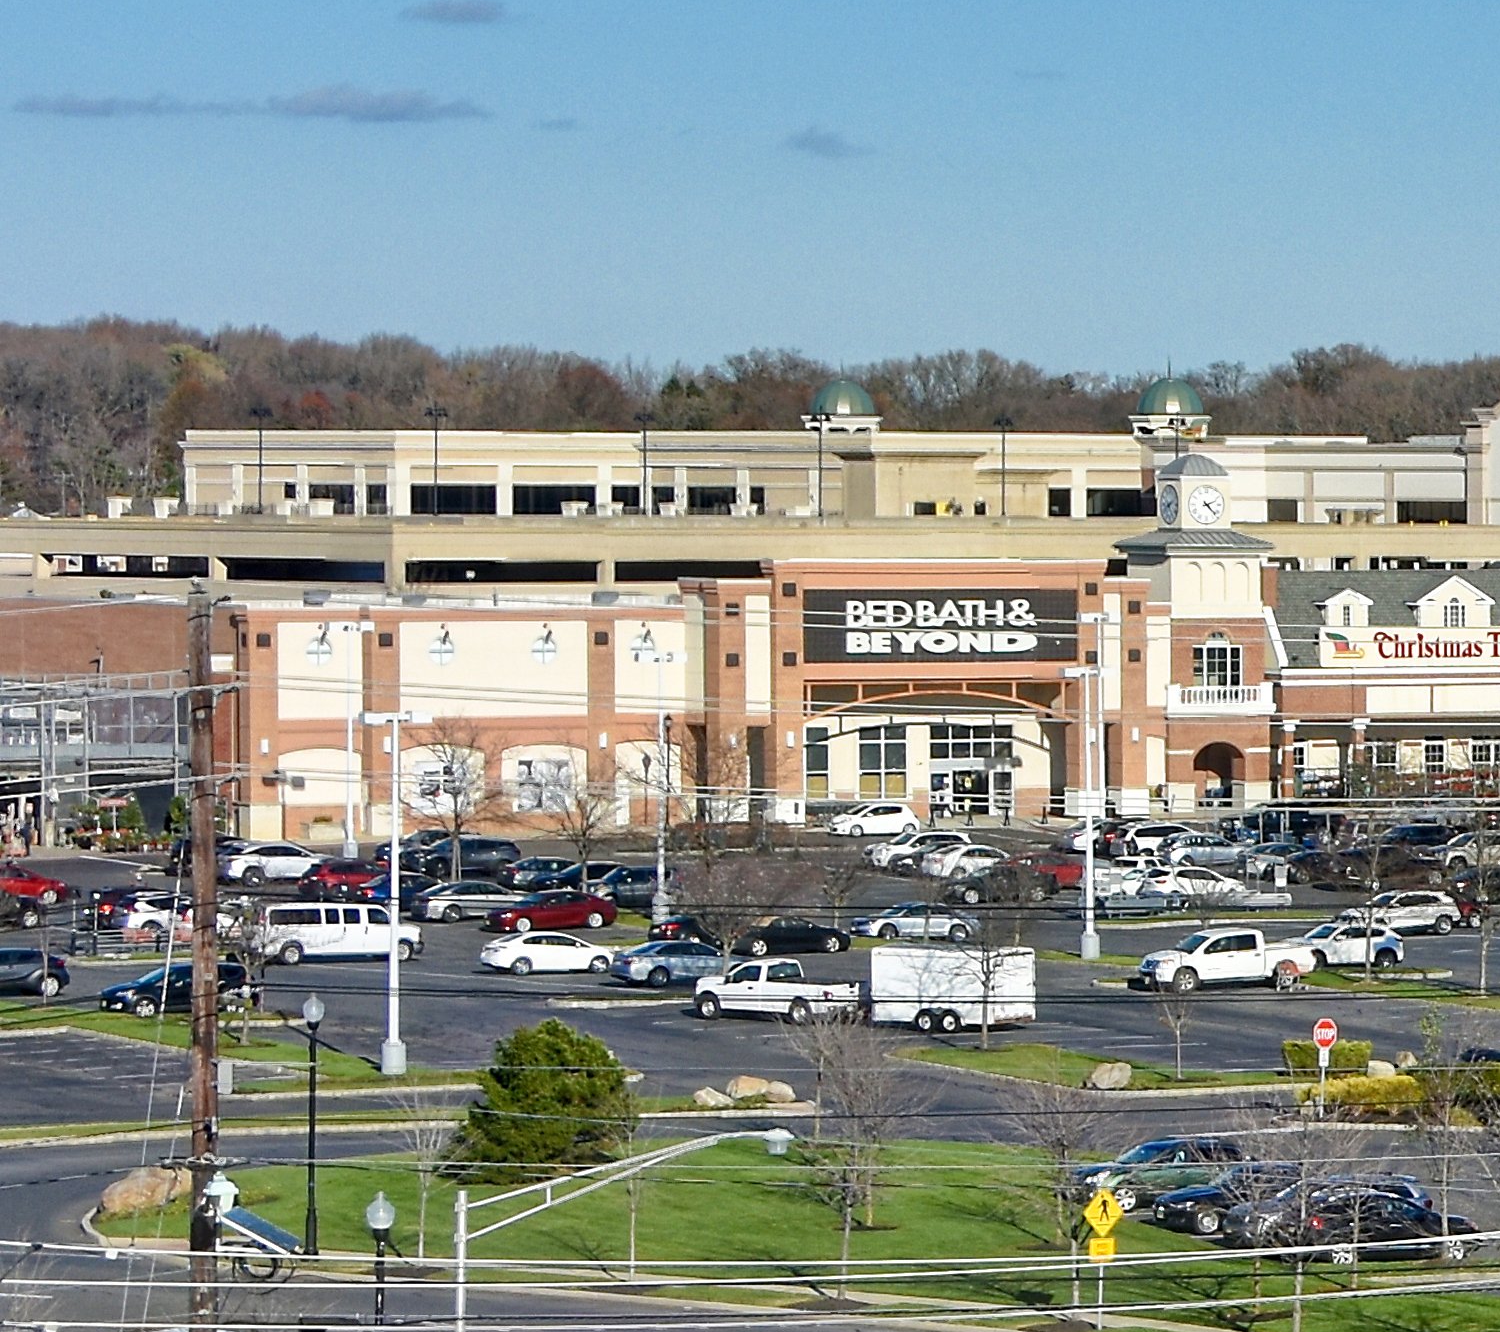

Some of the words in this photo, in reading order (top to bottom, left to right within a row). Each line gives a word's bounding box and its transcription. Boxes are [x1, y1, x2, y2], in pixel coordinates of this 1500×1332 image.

[846, 600, 913, 627] BED
[916, 599, 1004, 626] BATH
[1007, 598, 1038, 626] &
[846, 631, 1038, 654] BEYOND
[1374, 631, 1483, 659] Christmas
[1315, 1028, 1335, 1040] STOP
